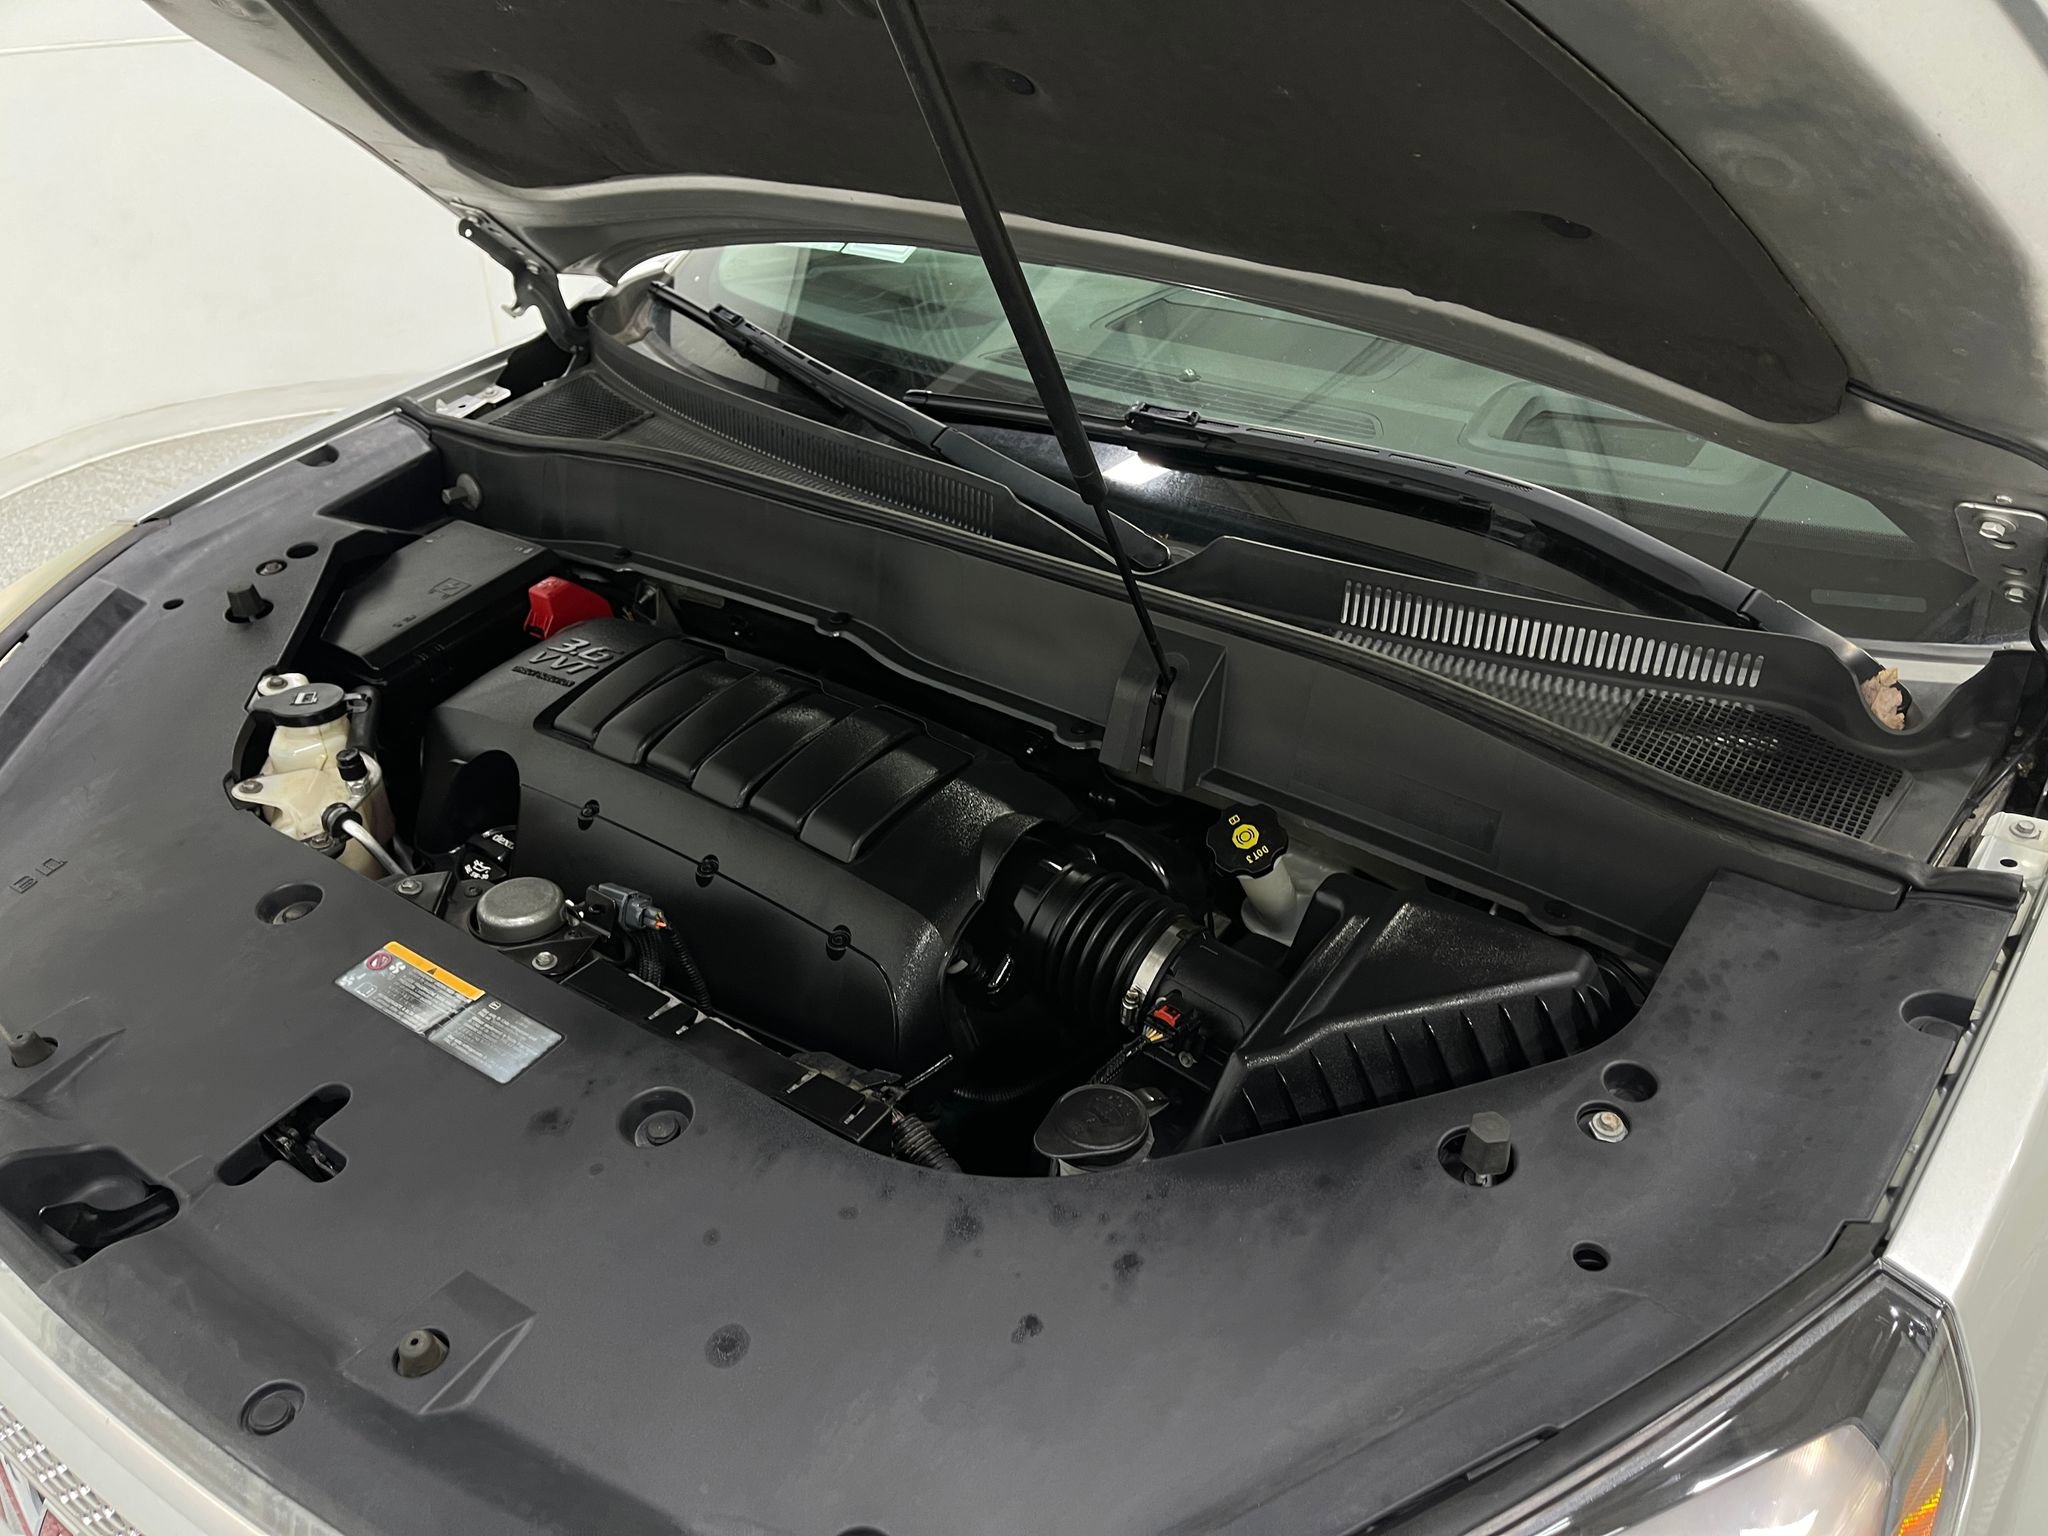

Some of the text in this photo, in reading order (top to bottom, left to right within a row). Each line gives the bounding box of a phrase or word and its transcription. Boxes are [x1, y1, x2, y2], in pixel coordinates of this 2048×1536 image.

[547, 638, 623, 662] 3.6
[528, 651, 599, 675] VVT
[1245, 845, 1269, 864] DOT 3
